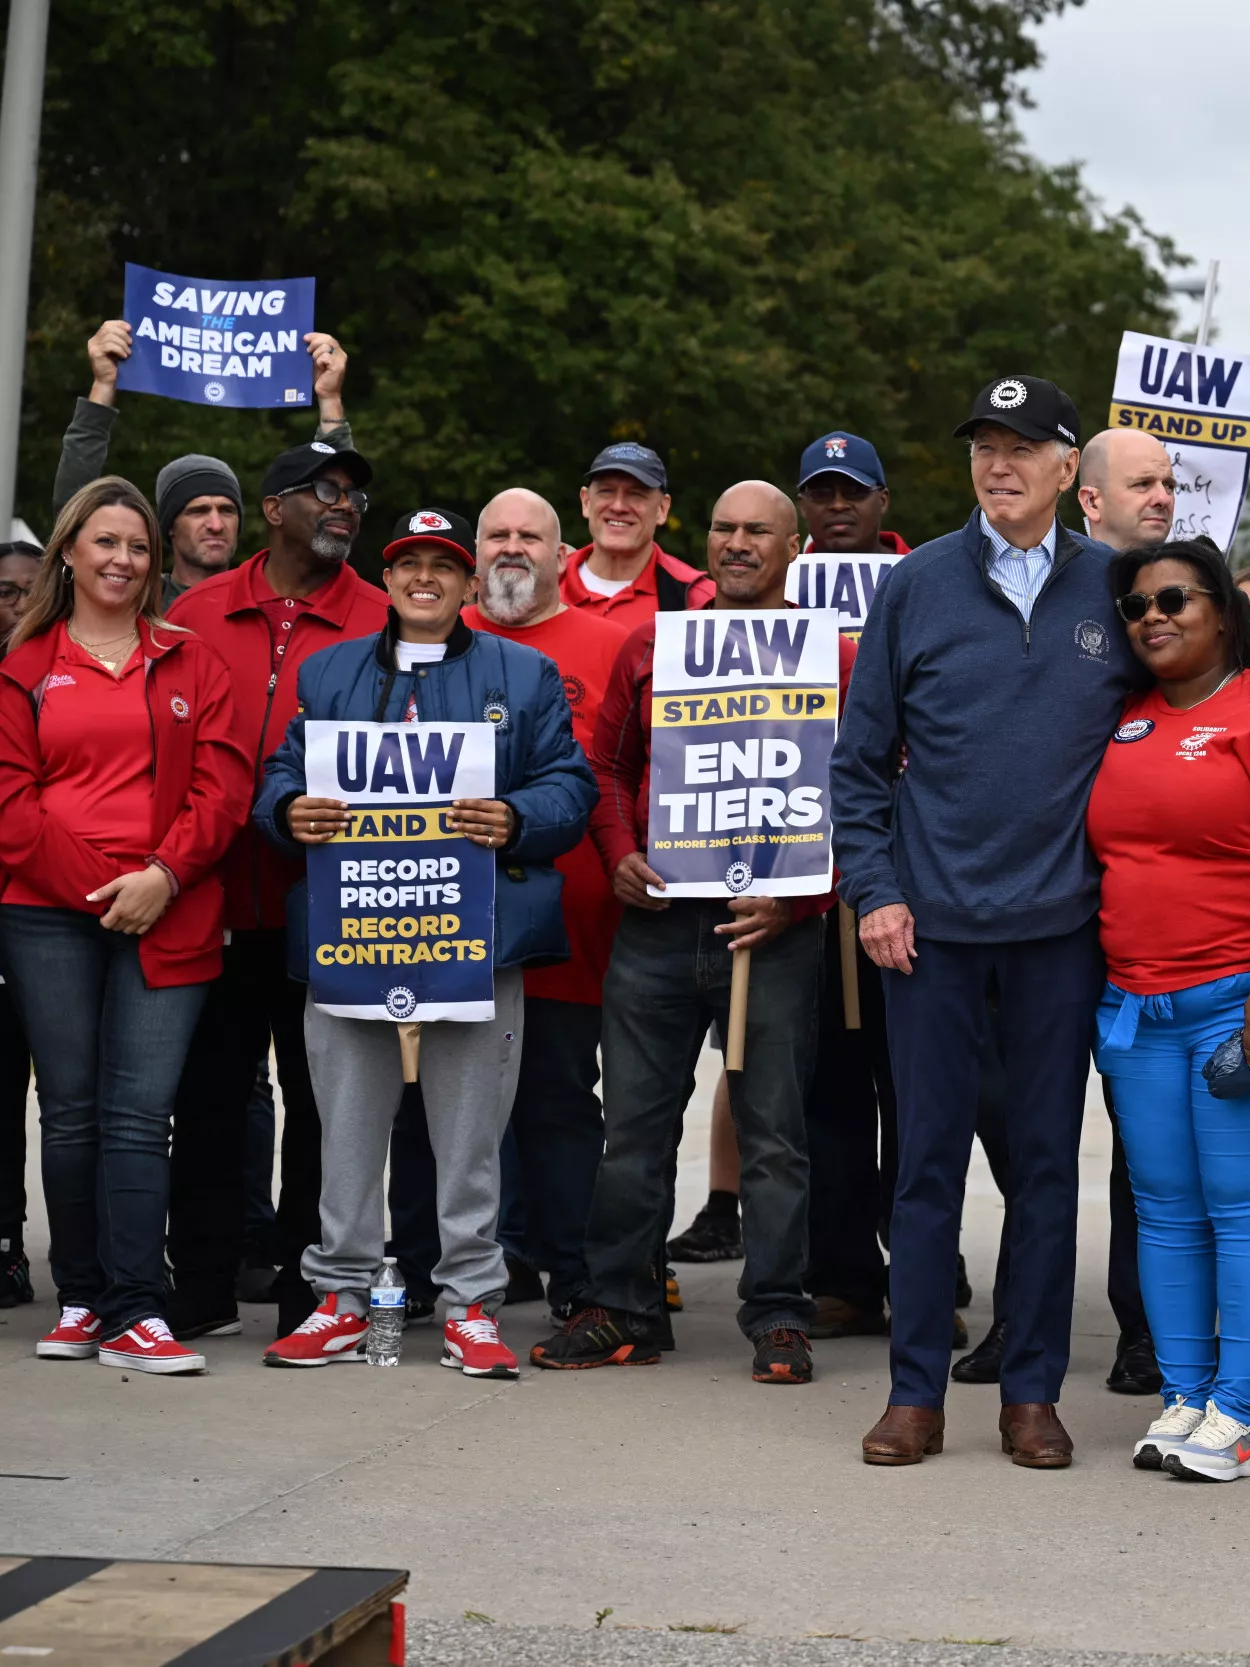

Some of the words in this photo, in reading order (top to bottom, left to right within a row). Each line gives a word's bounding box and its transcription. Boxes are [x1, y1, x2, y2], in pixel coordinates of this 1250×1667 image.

[152, 282, 286, 316] SAVING
[136, 316, 297, 354] AMERICAN
[202, 315, 236, 330] THE
[161, 345, 272, 378] DREAM
[1140, 344, 1242, 409] UAW
[1000, 389, 1017, 398] UAW
[1118, 409, 1202, 437] STAND
[1212, 420, 1247, 442] UP
[684, 618, 809, 678] UAW
[663, 693, 771, 722] STAND
[782, 692, 826, 716] UP
[337, 730, 466, 794] UAW
[684, 738, 802, 785] END
[658, 786, 823, 833] TIERS
[336, 814, 427, 838] TAND
[654, 841, 672, 850] NO
[674, 839, 707, 849] MORE
[709, 839, 731, 848] 2ND
[732, 835, 766, 846] CLASS
[768, 833, 824, 844] WORKERS
[340, 856, 460, 882] RECORD
[340, 883, 461, 908] PROFITS
[341, 914, 460, 938] RECORD
[315, 939, 487, 966] CONTRACTS
[393, 998, 407, 1006] UAW
